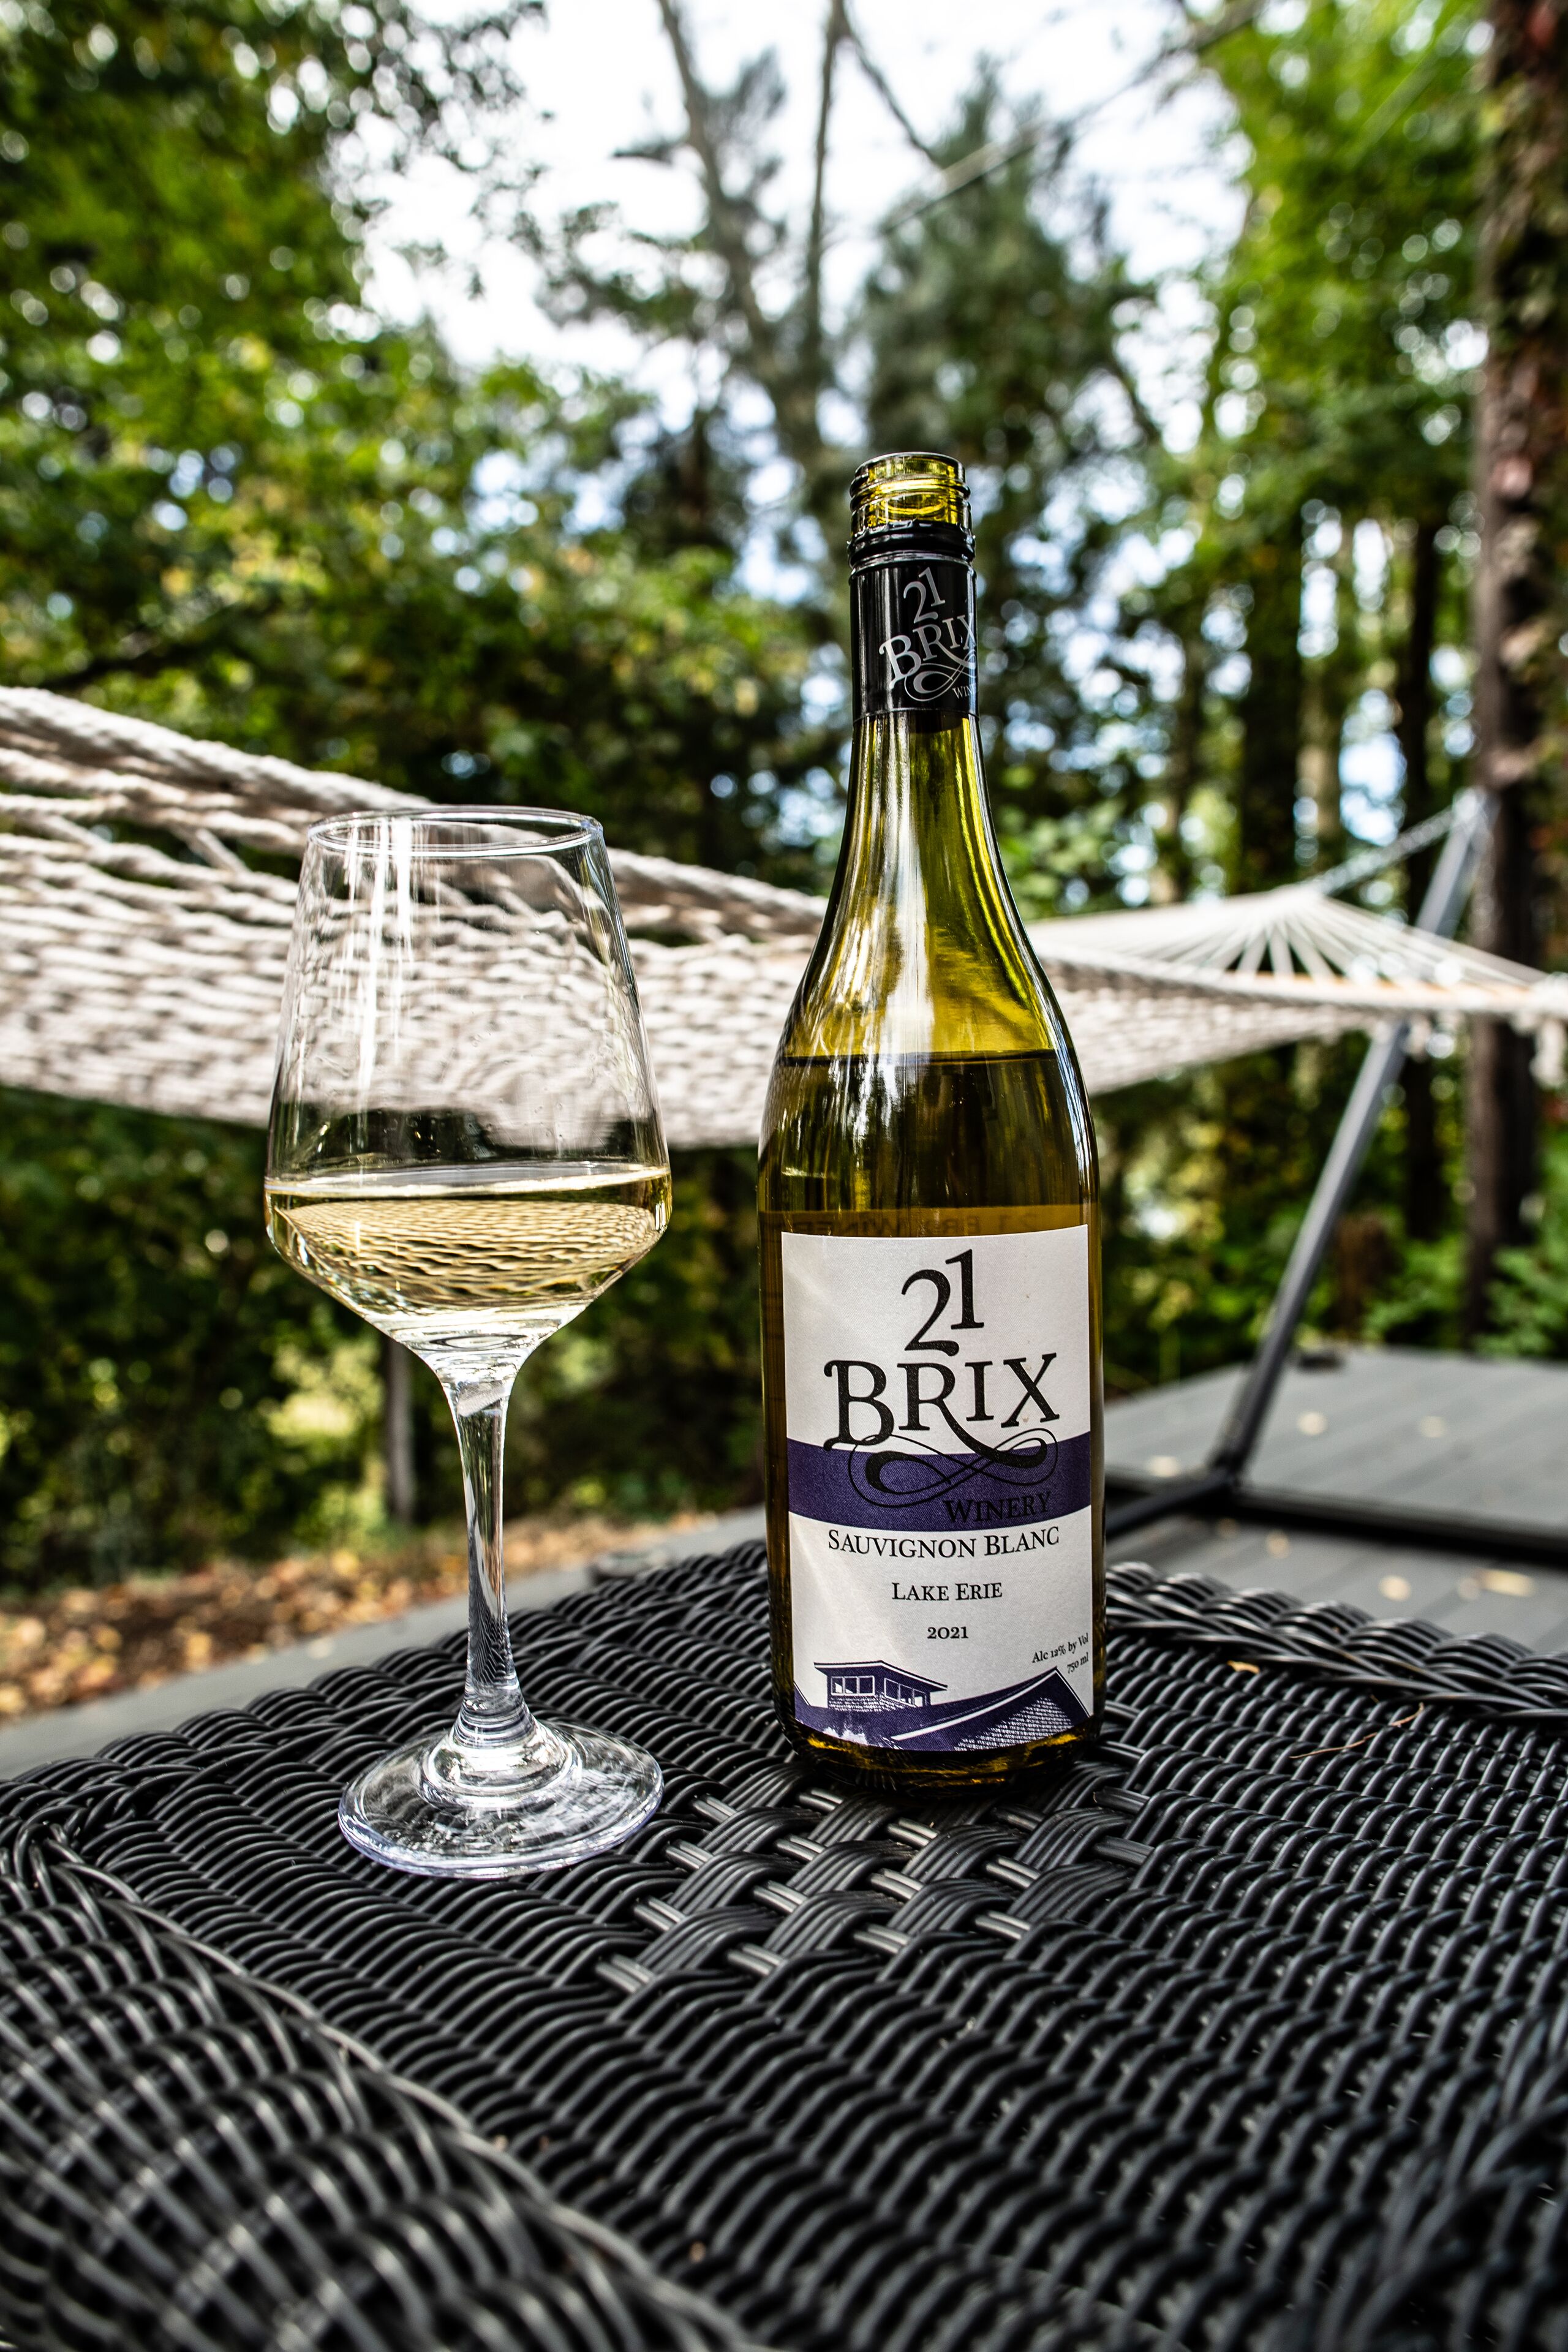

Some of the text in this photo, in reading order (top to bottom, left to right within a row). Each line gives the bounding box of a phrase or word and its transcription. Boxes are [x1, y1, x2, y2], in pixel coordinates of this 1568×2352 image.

[903, 566, 945, 624] 21
[878, 614, 976, 690] BRIX
[901, 1248, 984, 1357] 21
[823, 1352, 1060, 1469] BRIX
[942, 1491, 1052, 1523] WINERY
[827, 1526, 1060, 1558] SAUVIGNON BLANC
[891, 1582, 1003, 1601] LAKE ERIE
[927, 1626, 968, 1640] 2021
[1031, 1632, 1088, 1663] Alc 12% by Vol
[1067, 1651, 1088, 1674] 750 ml
